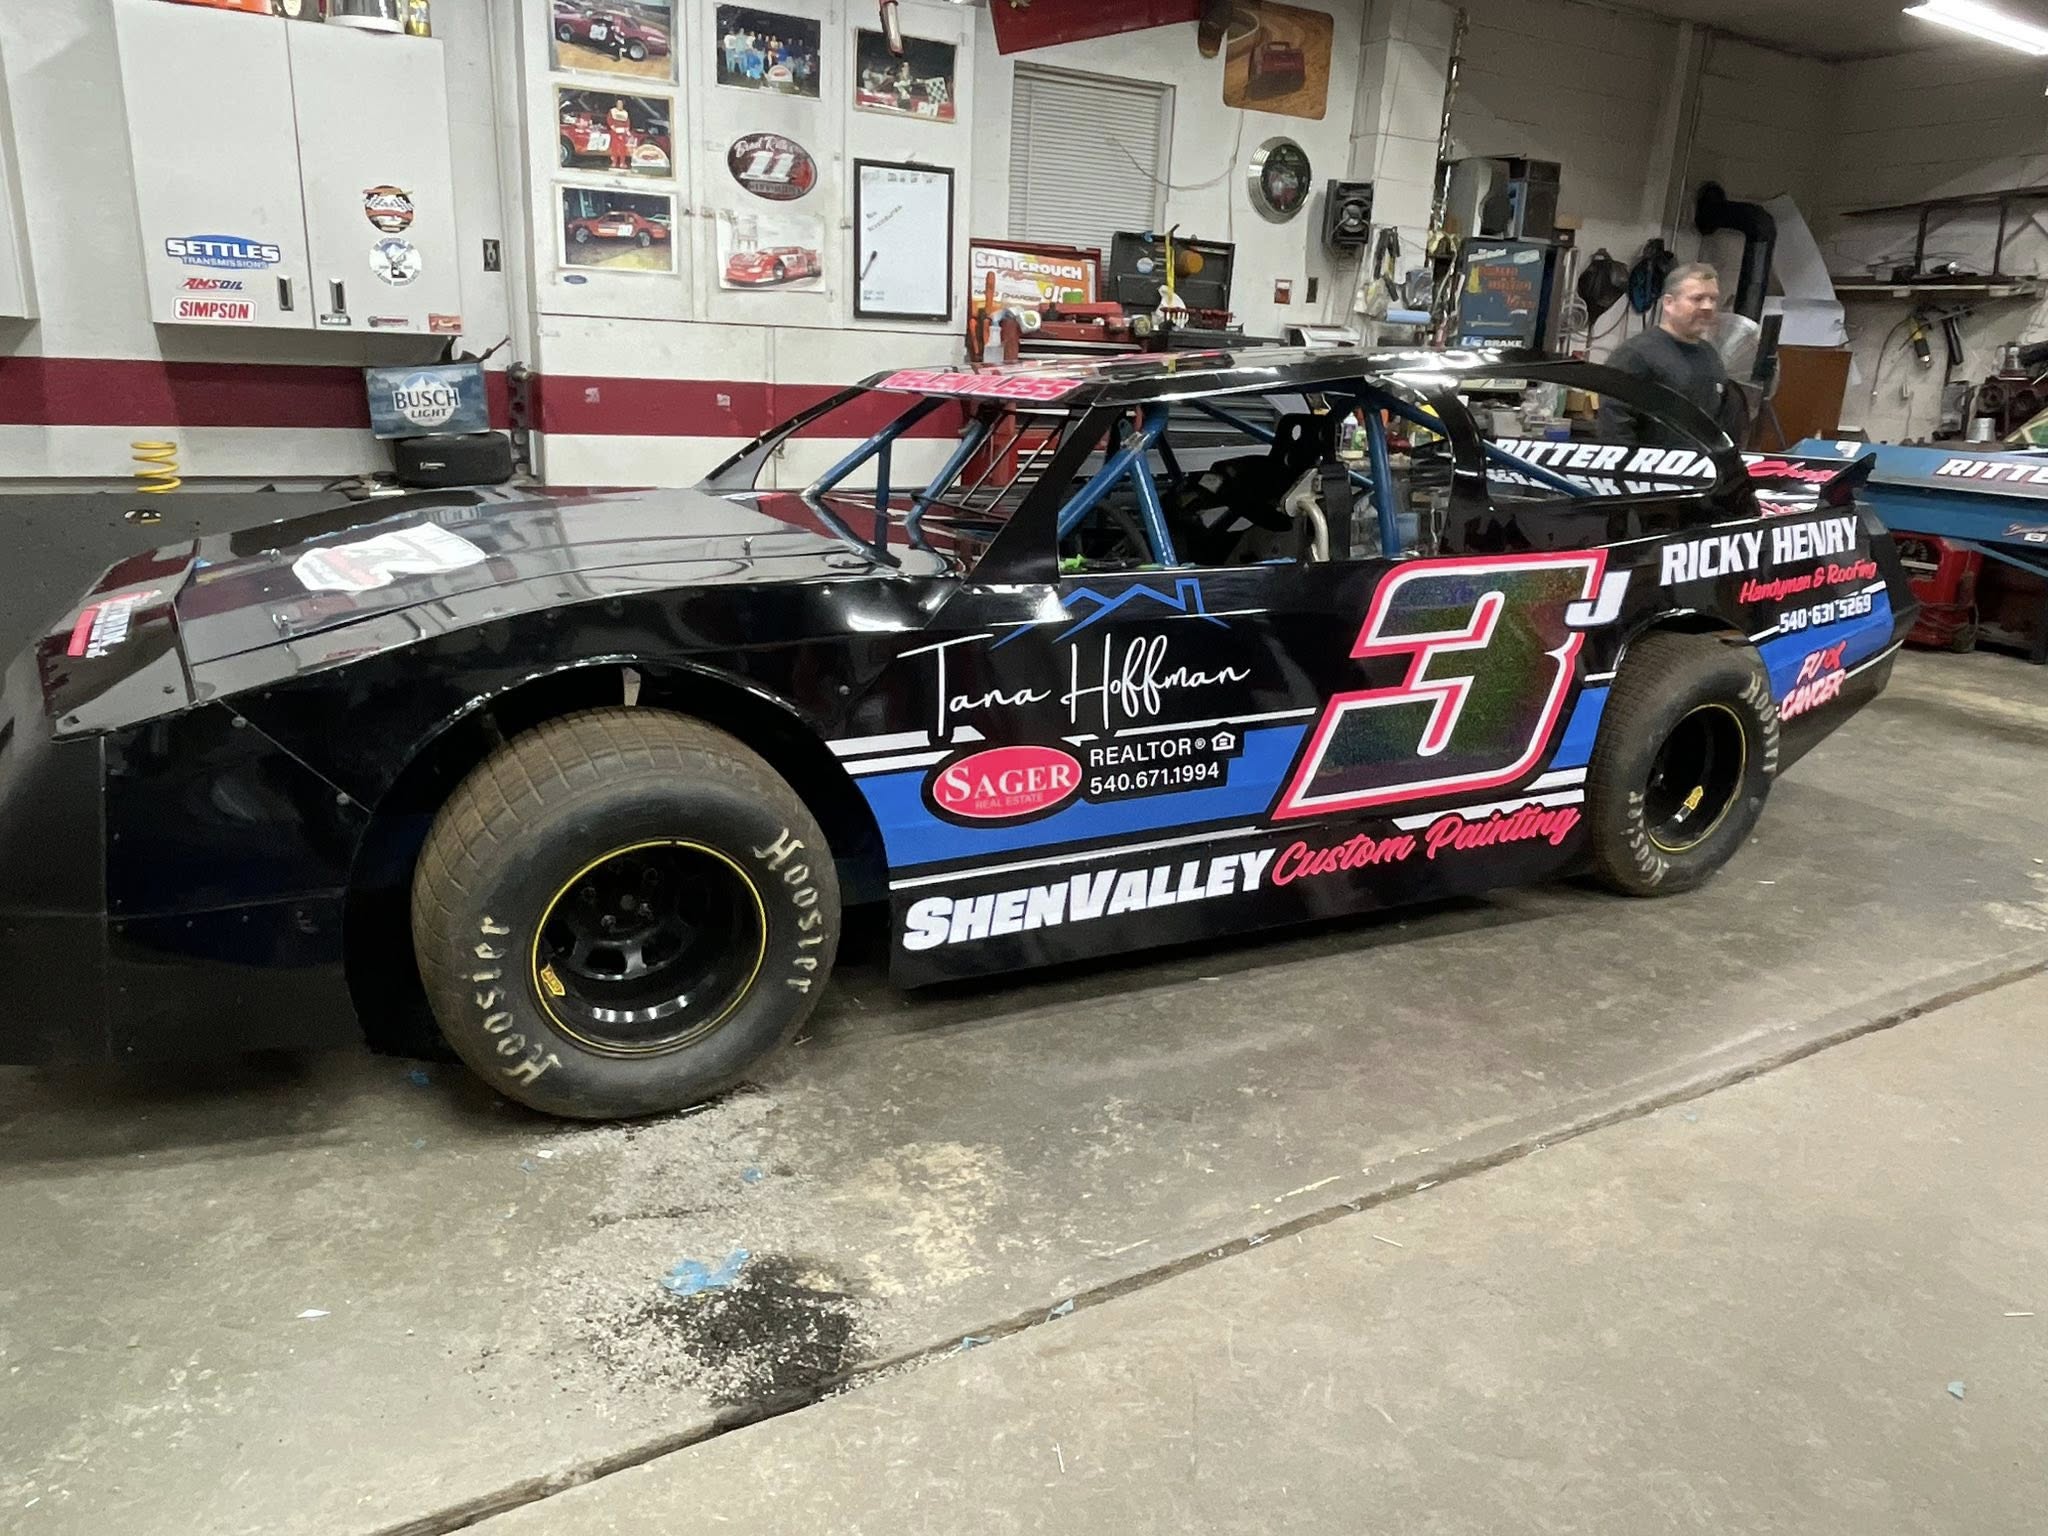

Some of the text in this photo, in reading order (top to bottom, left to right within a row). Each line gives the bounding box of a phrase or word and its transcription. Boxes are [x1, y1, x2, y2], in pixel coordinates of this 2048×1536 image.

[166, 239, 280, 262] SETTLES
[976, 252, 1014, 270] SAM
[1019, 261, 1083, 280] CROUCH
[183, 277, 243, 290] AMSOIL
[180, 301, 249, 319] SIMPSON
[394, 389, 459, 410] BUSCH
[411, 408, 447, 418] LIGHT
[1624, 447, 1717, 478] ROA
[1660, 516, 1858, 587] RICKY HENRY
[1740, 575, 1812, 604] Handyman
[1813, 567, 1825, 588] &
[1060, 633, 1251, 730] Hoffman
[1779, 668, 1847, 720] CANCER
[944, 763, 1073, 803] SAGER
[1090, 762, 1220, 795] 540.671.1994
[974, 792, 1043, 810] REAL ESTATE
[1272, 837, 1415, 886] Custom
[1426, 806, 1582, 859] Painting
